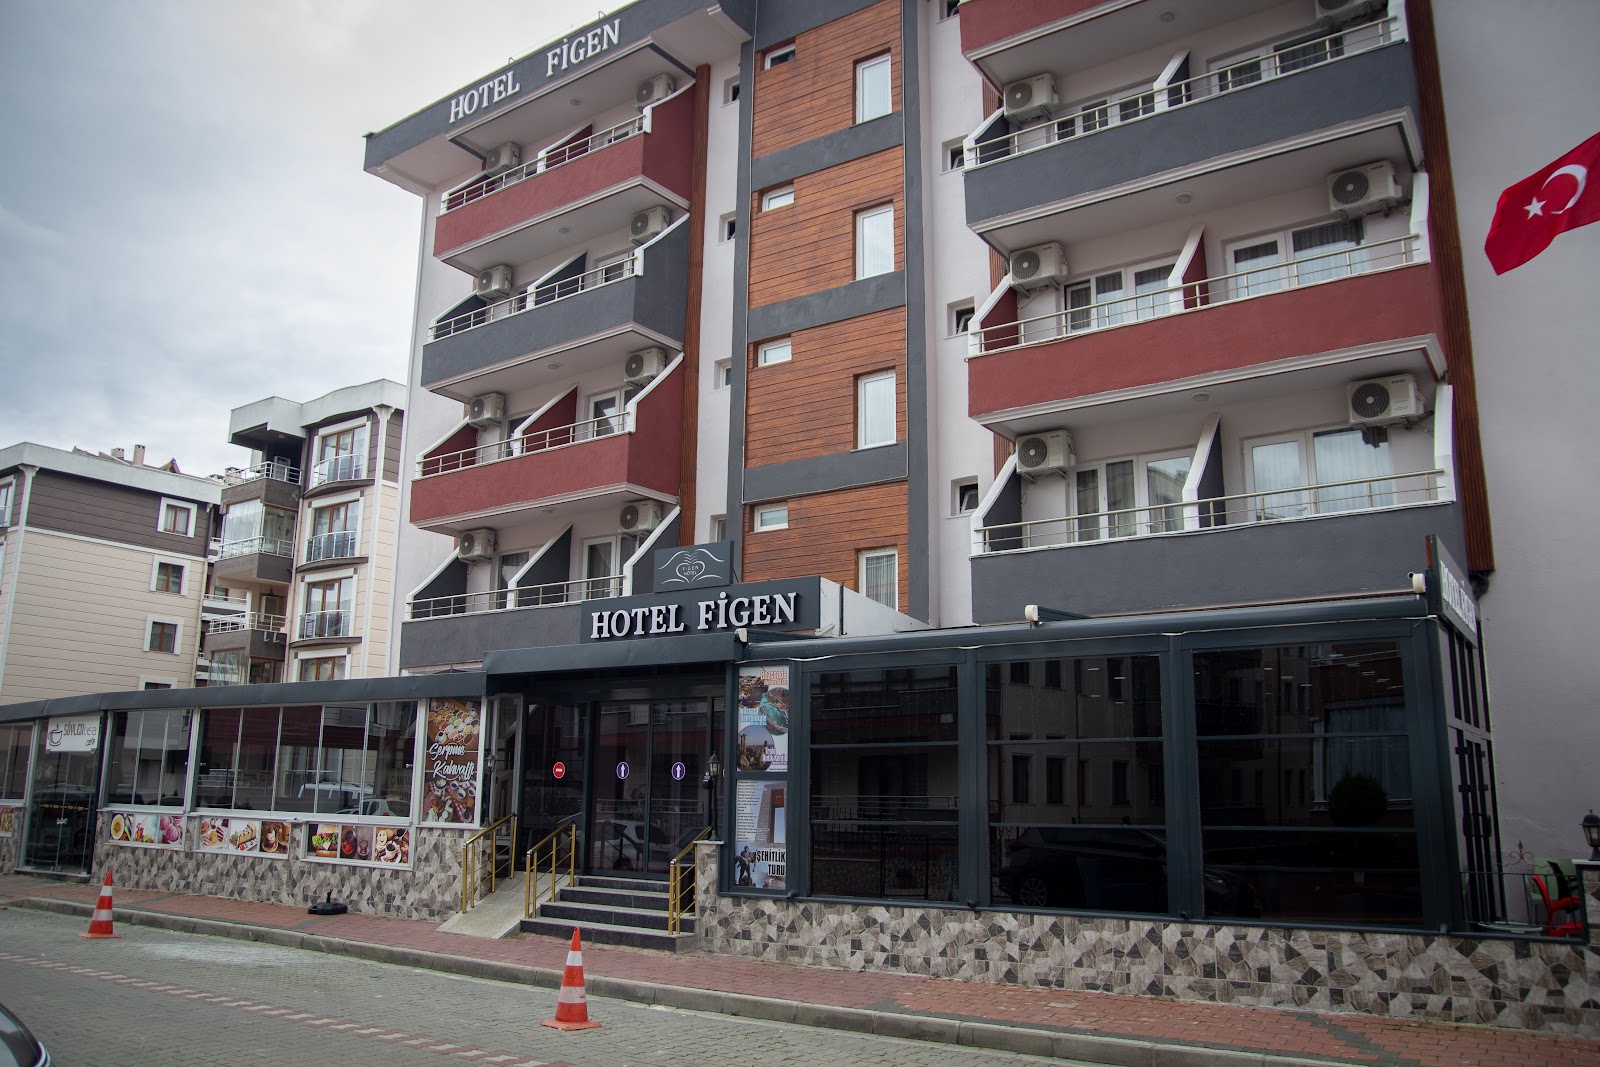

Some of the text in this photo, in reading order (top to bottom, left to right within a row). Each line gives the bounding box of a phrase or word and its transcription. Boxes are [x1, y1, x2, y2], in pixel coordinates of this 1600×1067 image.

[449, 18, 621, 123] HOTEL FİGEN
[590, 591, 797, 639] HOTEL FİGEN
[429, 742, 465, 760] Serpme
[757, 849, 786, 863] ŞEHİTLİK
[768, 864, 785, 876] TURU
